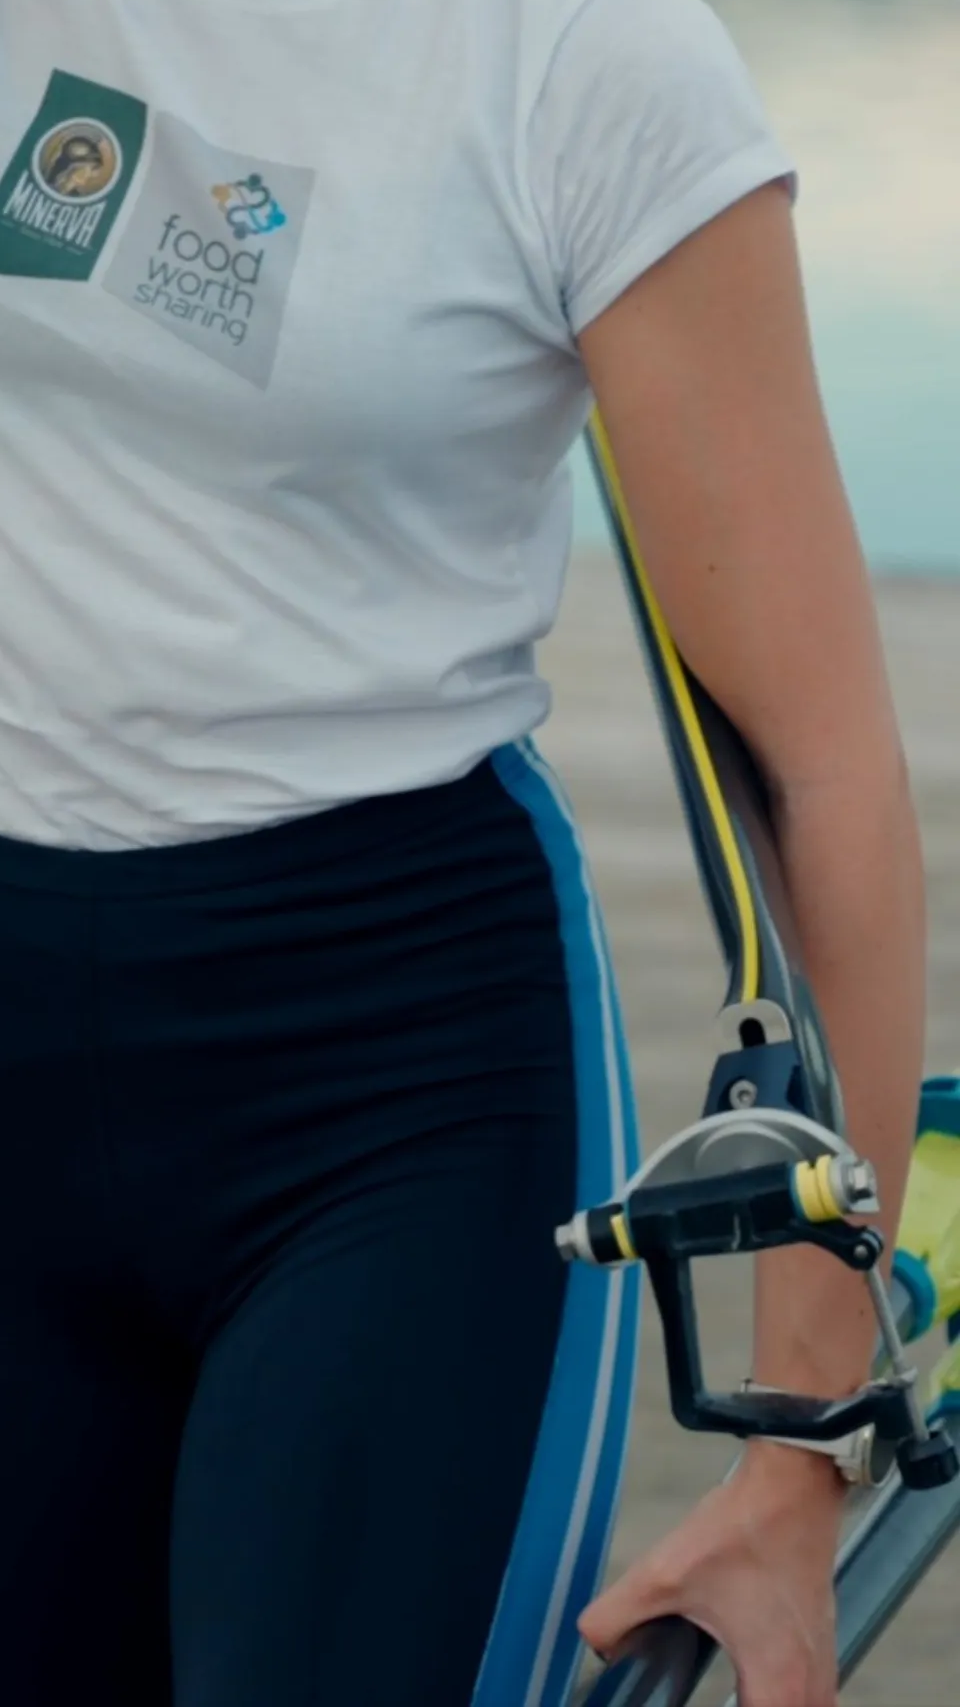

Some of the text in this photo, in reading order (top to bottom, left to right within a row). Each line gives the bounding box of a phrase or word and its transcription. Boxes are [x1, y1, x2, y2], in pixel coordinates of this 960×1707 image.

[3, 169, 107, 248] MINERVA
[158, 214, 264, 285] food
[133, 283, 248, 346] sharing
[148, 256, 254, 319] worth
